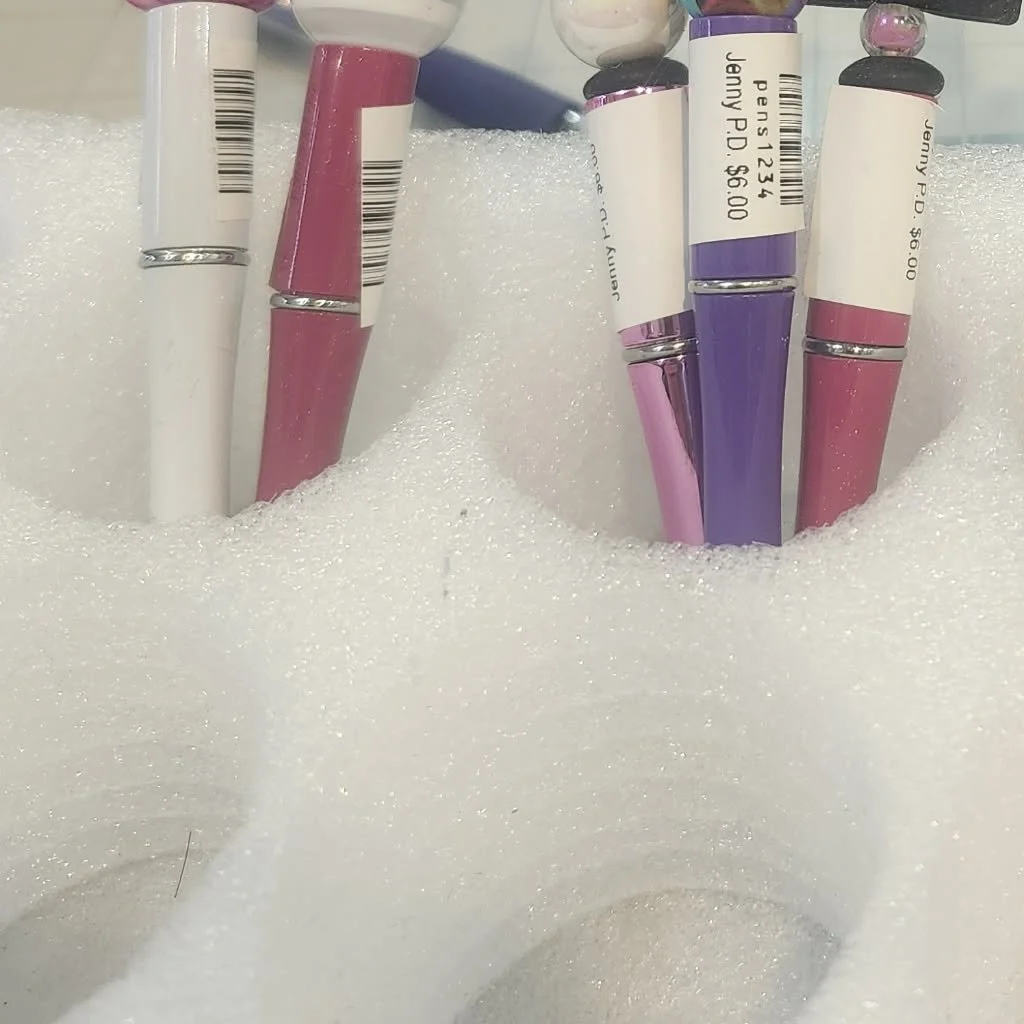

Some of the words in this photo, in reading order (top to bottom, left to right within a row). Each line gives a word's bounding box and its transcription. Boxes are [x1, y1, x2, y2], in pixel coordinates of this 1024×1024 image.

[720, 52, 747, 111] Jenny
[725, 118, 748, 158] P.D.
[753, 78, 775, 200] pens1234
[916, 119, 934, 176] Jenny
[724, 164, 751, 221] $6.00
[605, 245, 620, 302] Jenny
[905, 226, 923, 282] $6.00
